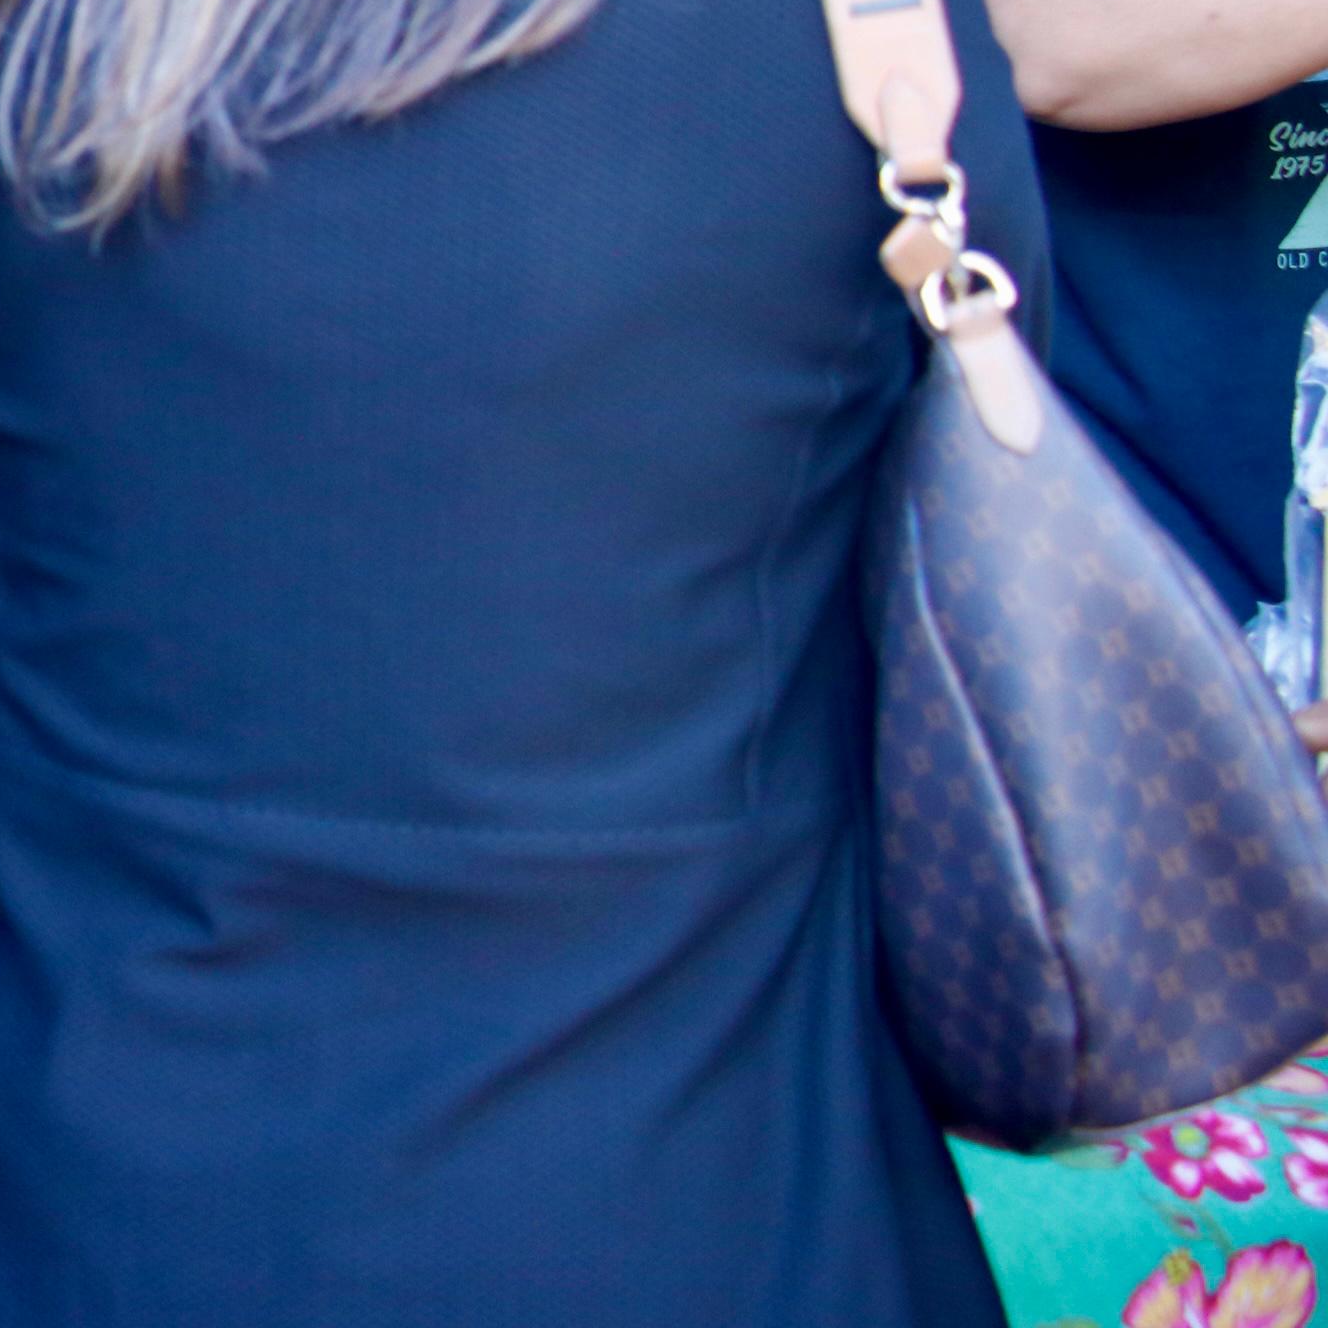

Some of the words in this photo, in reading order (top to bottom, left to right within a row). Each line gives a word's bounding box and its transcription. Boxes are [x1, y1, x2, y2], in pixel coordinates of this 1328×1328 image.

[1269, 121, 1328, 152] Sinc
[1270, 154, 1326, 180] 1975
[1277, 252, 1310, 270] OLD
